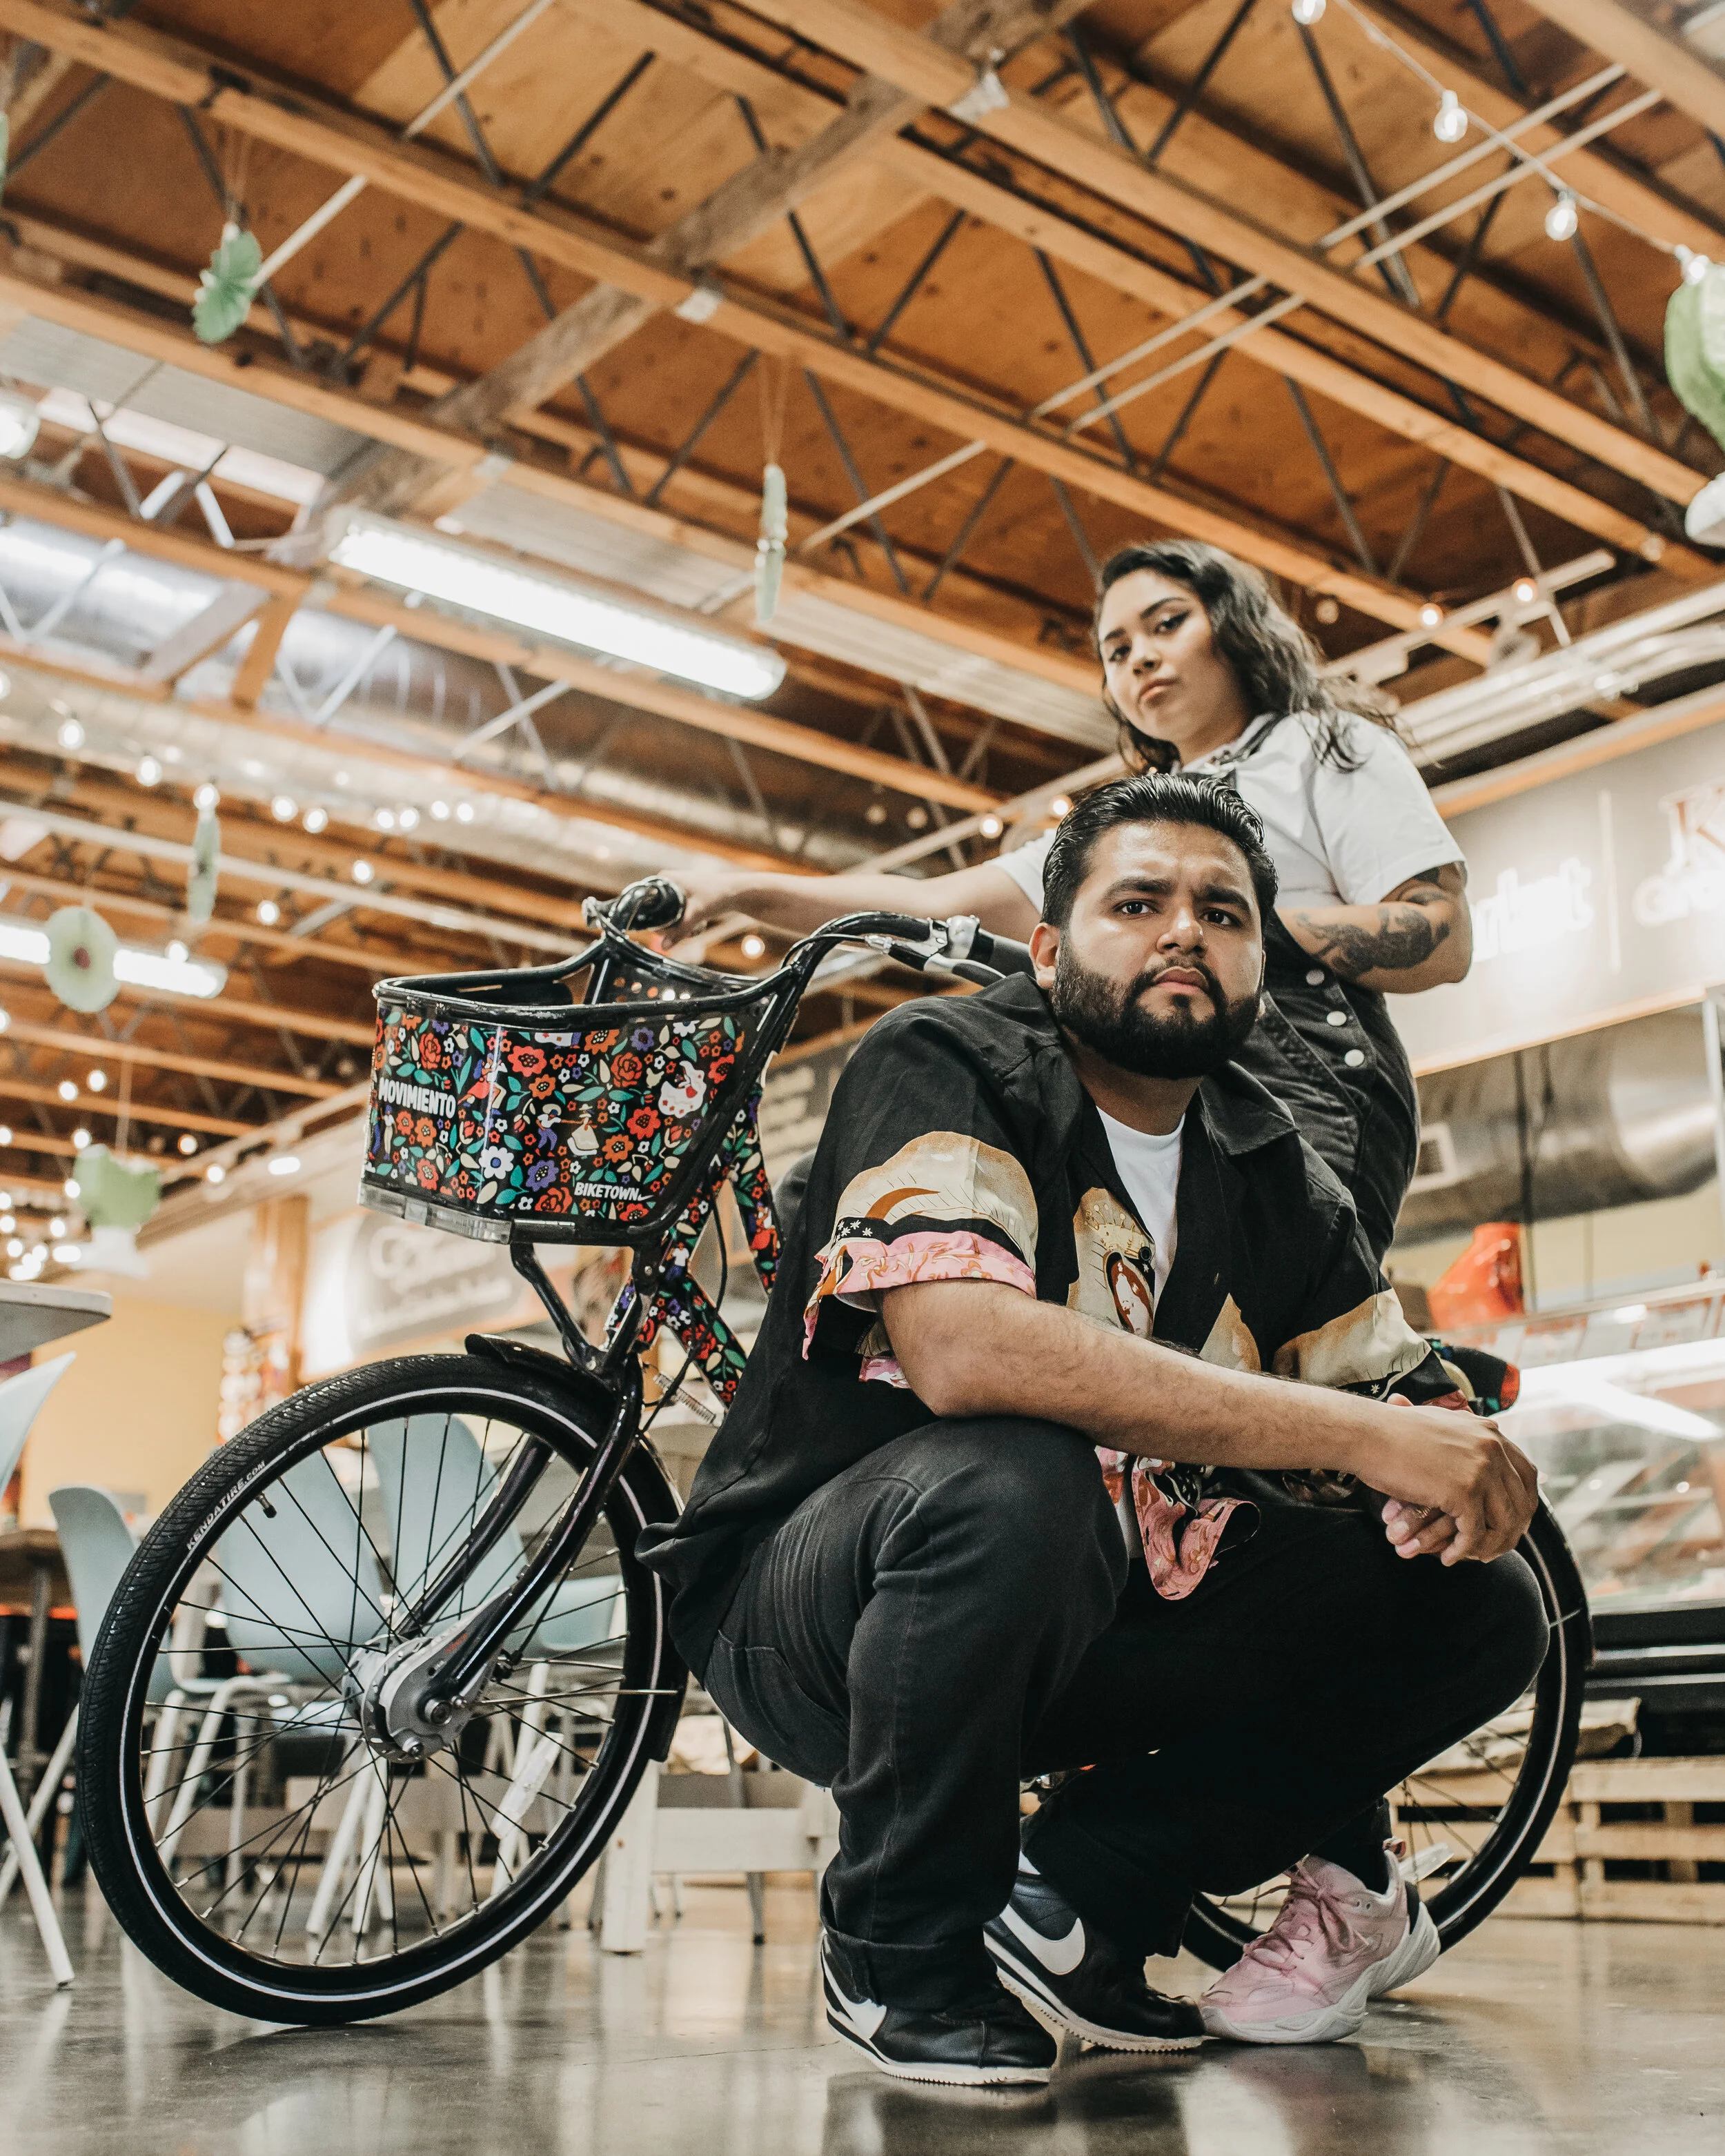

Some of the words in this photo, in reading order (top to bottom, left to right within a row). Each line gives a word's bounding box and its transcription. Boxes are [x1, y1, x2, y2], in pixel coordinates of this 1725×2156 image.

[378, 1077, 456, 1119] MOVIMIENTO
[574, 1182, 640, 1201] BIKETOWN
[186, 1459, 266, 1550] KENDATIRE.COM
